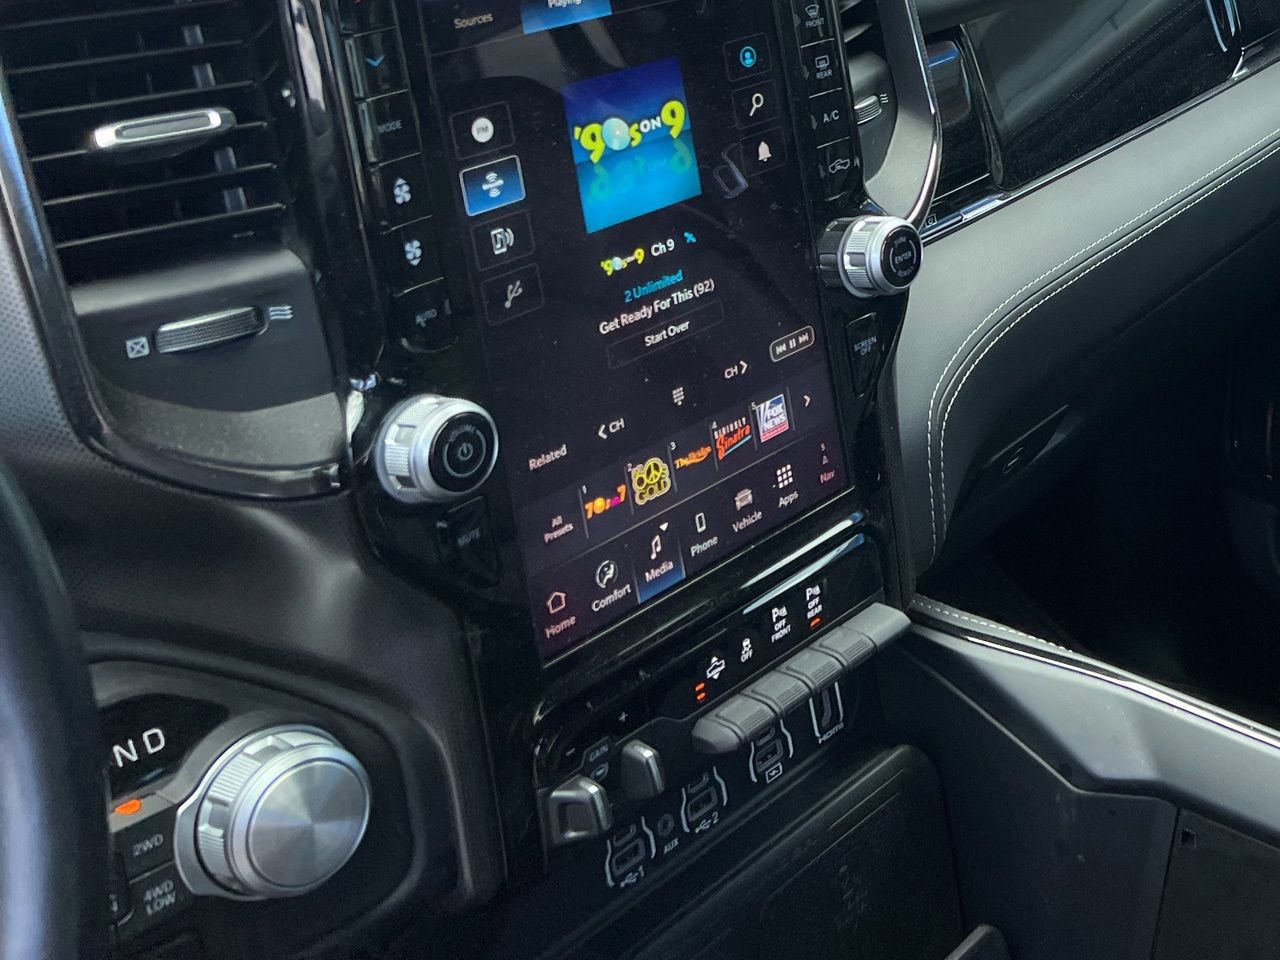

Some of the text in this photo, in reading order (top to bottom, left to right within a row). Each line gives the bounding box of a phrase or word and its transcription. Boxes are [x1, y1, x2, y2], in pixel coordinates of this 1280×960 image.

[454, 12, 494, 29] Sources
[805, 17, 825, 28] FRONT
[815, 69, 833, 80] REAR
[639, 115, 663, 133] ON
[660, 100, 686, 139] 9
[822, 109, 840, 124] A/C
[650, 242, 666, 257] Ch
[665, 238, 676, 251] 9
[624, 269, 684, 303] 2 Unlimited
[598, 278, 716, 335] Get Ready For This (92)
[643, 320, 690, 347] Start Over
[724, 365, 739, 379] CH
[767, 402, 785, 420] FOX
[608, 418, 625, 433] CH
[529, 443, 568, 471] Related
[819, 469, 835, 484] Nav
[778, 490, 799, 509] Apps
[551, 515, 563, 528] All
[731, 510, 763, 533] Vehicle
[543, 522, 574, 544] Presets
[690, 535, 719, 558] Phone
[644, 559, 674, 583] Media
[591, 583, 633, 612] Comfort
[807, 597, 821, 610] OFF
[806, 603, 823, 620] REAR
[544, 615, 577, 639] Home
[770, 624, 792, 643] FRONT
[774, 619, 787, 631] OFF
[740, 648, 754, 663] OFF
[112, 727, 166, 767] N D
[133, 833, 164, 857] 2WD
[663, 837, 680, 855] AUX
[144, 878, 174, 903] 4WD
[146, 891, 177, 916] LOW
